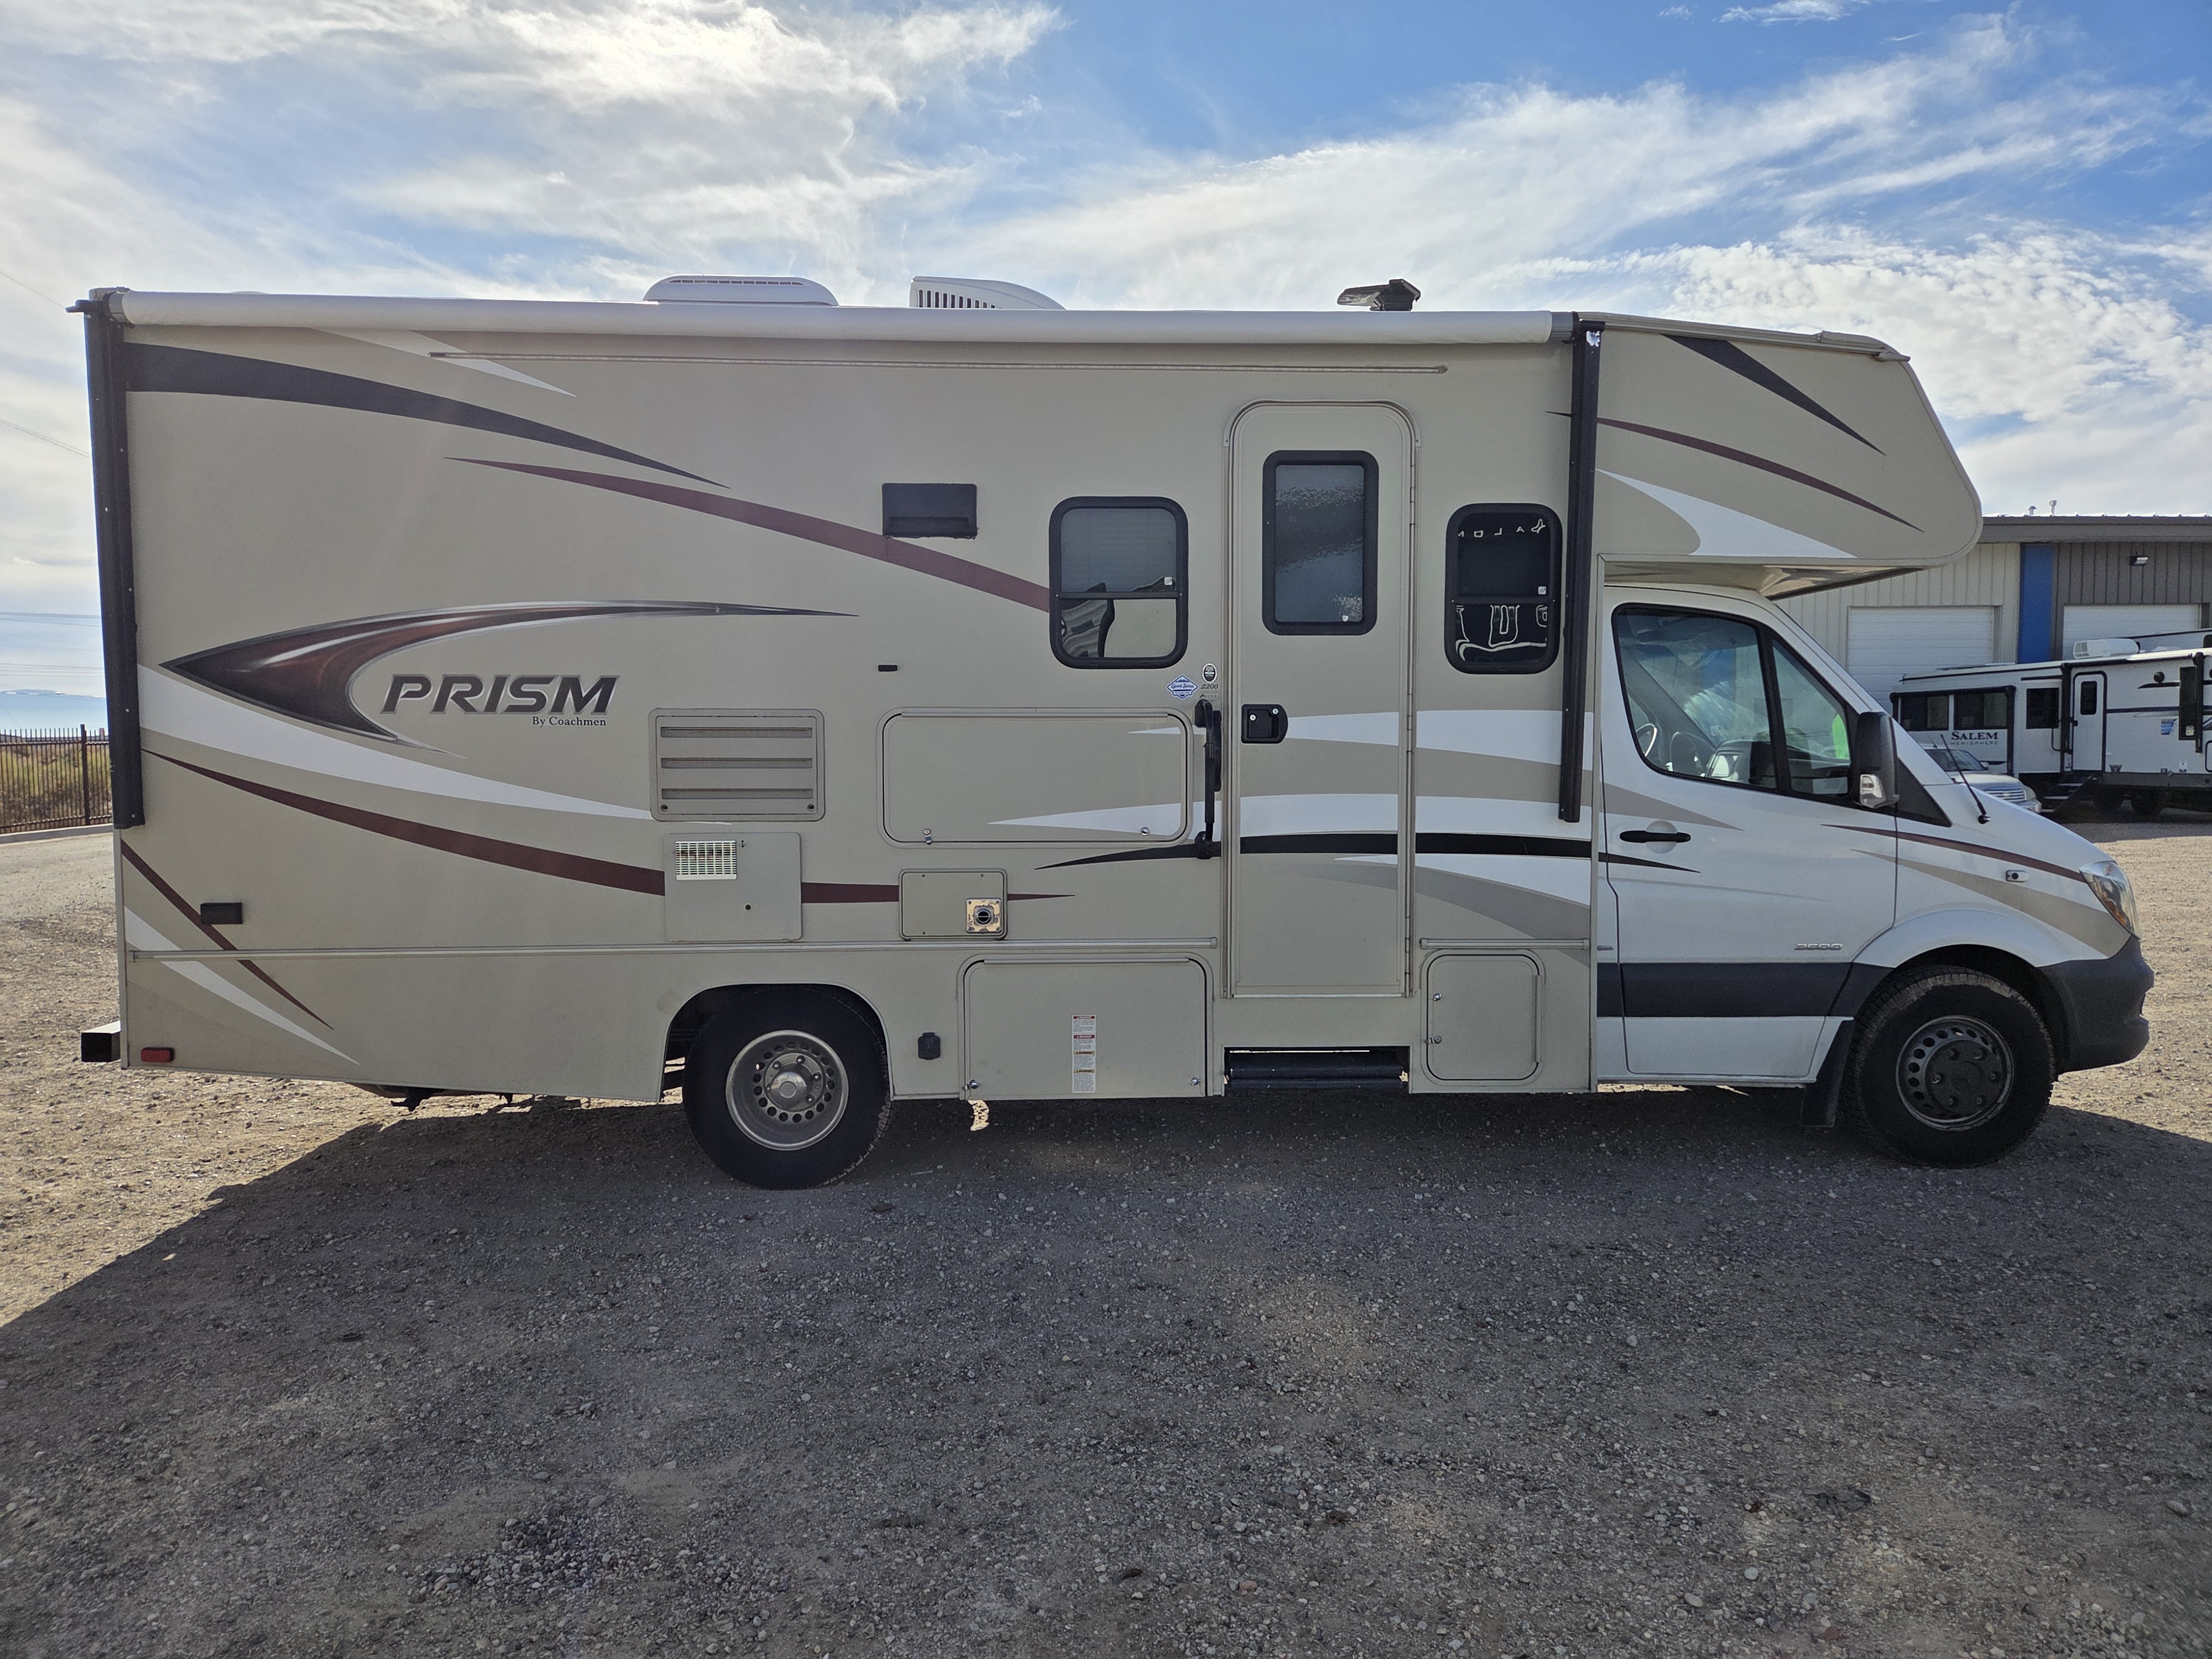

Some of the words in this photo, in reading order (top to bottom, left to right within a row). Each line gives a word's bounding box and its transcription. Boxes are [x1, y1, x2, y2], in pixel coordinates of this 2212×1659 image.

[380, 674, 620, 714] PRISM
[532, 716, 546, 728] By
[549, 716, 607, 726] Coachmen
[1951, 731, 1999, 740] SALEM
